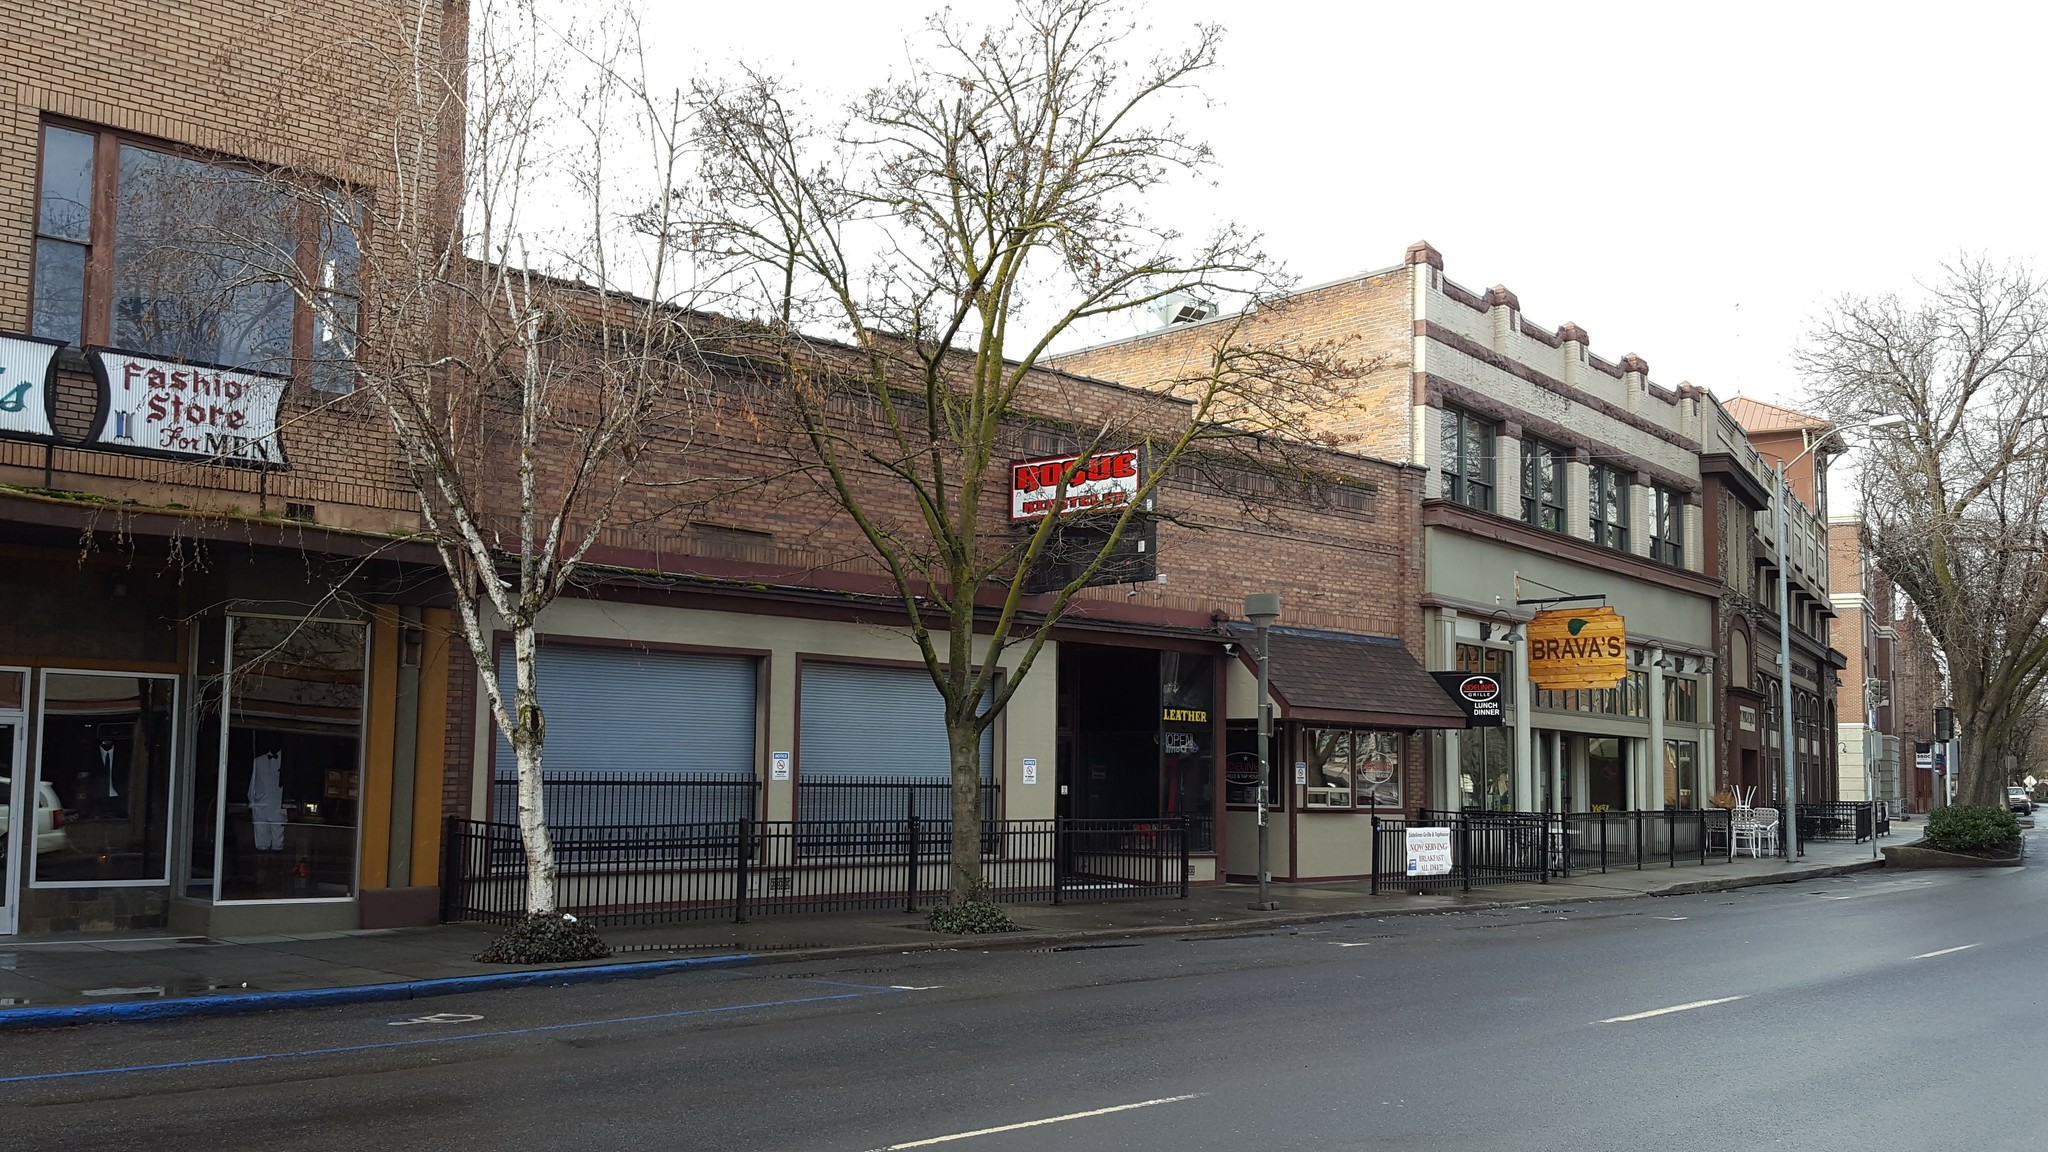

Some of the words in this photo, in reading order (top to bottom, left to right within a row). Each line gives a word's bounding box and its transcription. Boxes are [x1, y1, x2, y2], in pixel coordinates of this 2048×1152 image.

[123, 362, 251, 401] Fashio
[146, 391, 249, 430] Store
[160, 426, 200, 450] For
[204, 432, 269, 461] MEN
[1015, 453, 1136, 493] ROGUE
[1532, 635, 1621, 660] BRAVA'S
[1463, 683, 1496, 691] SIDELINES
[1163, 708, 1207, 722] LEATHER
[1167, 733, 1193, 747] OPEN
[1410, 843, 1424, 851] NOW
[1424, 842, 1448, 850] SERVING
